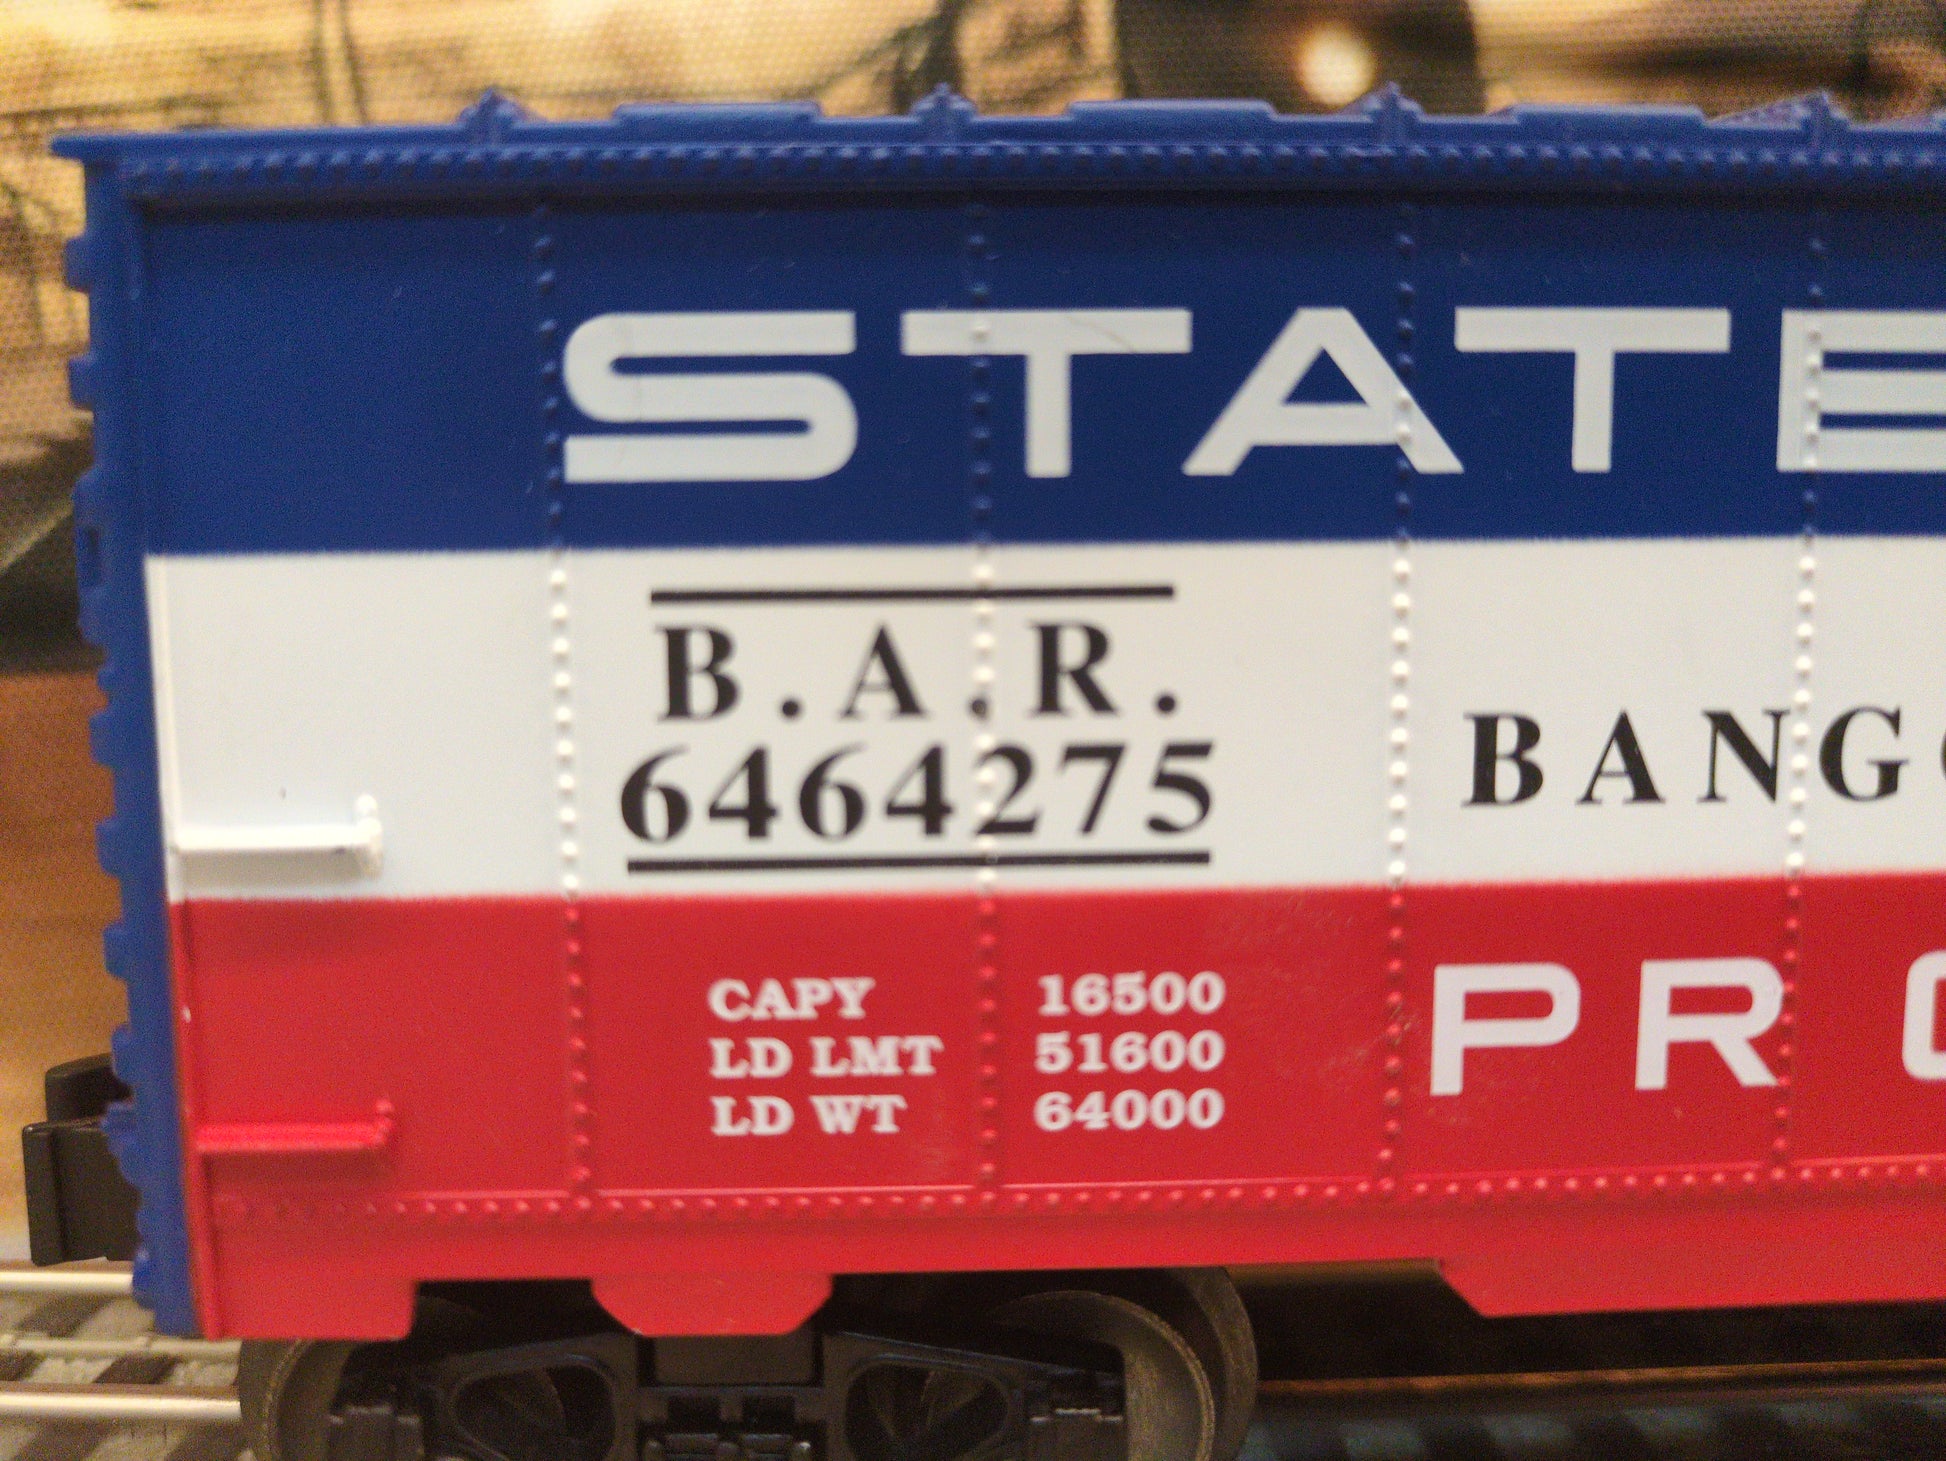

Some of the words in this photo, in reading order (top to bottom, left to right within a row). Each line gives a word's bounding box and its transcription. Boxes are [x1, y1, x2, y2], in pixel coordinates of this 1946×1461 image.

[562, 306, 1946, 484] STATE
[655, 622, 1177, 722] B.A.R.
[619, 739, 1214, 841] 6464275
[1461, 705, 1946, 807] BANG
[707, 977, 876, 1022] CAPY
[1037, 971, 1226, 1016] 16500
[709, 1036, 793, 1078] LD
[809, 1035, 944, 1077] LMT
[1034, 1030, 1226, 1074] 51600
[711, 1095, 794, 1136] LD
[811, 1094, 907, 1134] WT
[1033, 1088, 1225, 1131] 64000
